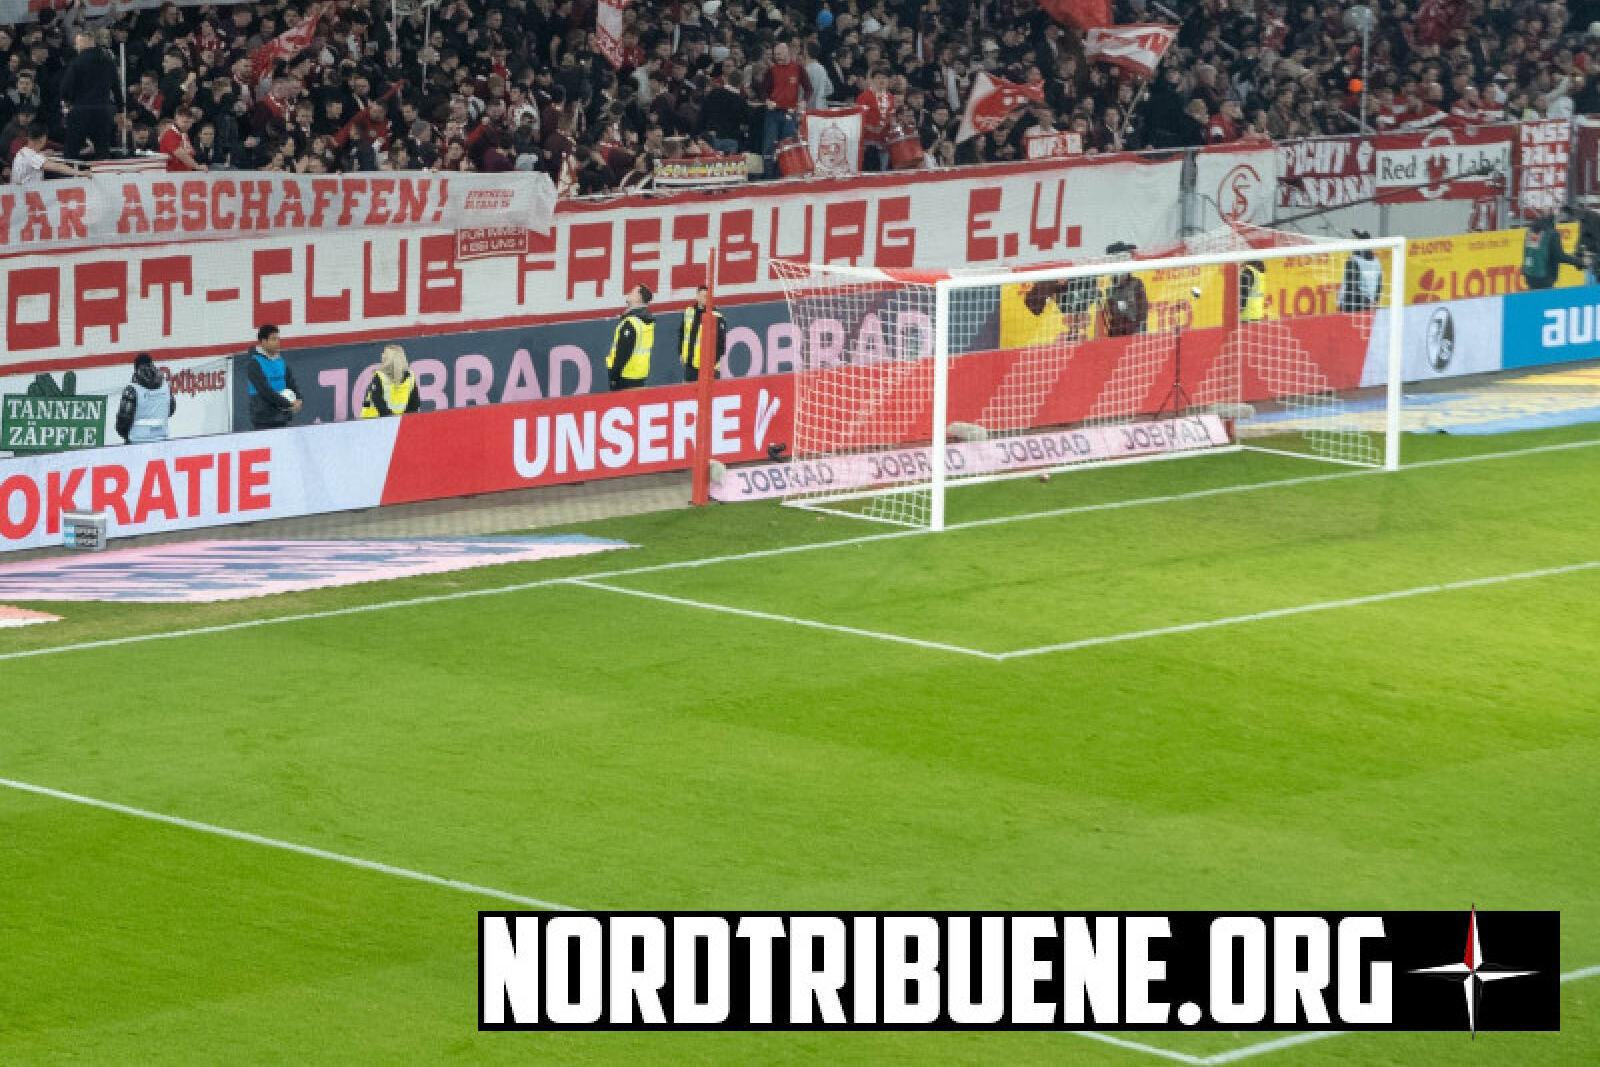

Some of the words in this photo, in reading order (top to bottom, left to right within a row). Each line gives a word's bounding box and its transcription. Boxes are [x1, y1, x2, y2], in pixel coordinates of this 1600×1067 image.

[1382, 155, 1417, 180] Red
[116, 178, 449, 233] ABSCHAFFEN!
[517, 196, 916, 305] FREIBURG
[1541, 304, 1600, 348] au
[722, 311, 934, 383] OBRAD
[7, 400, 103, 420] TANNEN
[9, 420, 97, 447] ZÄPFLE
[512, 394, 742, 478] UNSERE
[995, 433, 1092, 464] JOBRAD
[1121, 418, 1209, 451] JOBRAD
[741, 462, 834, 495] JOBRAD
